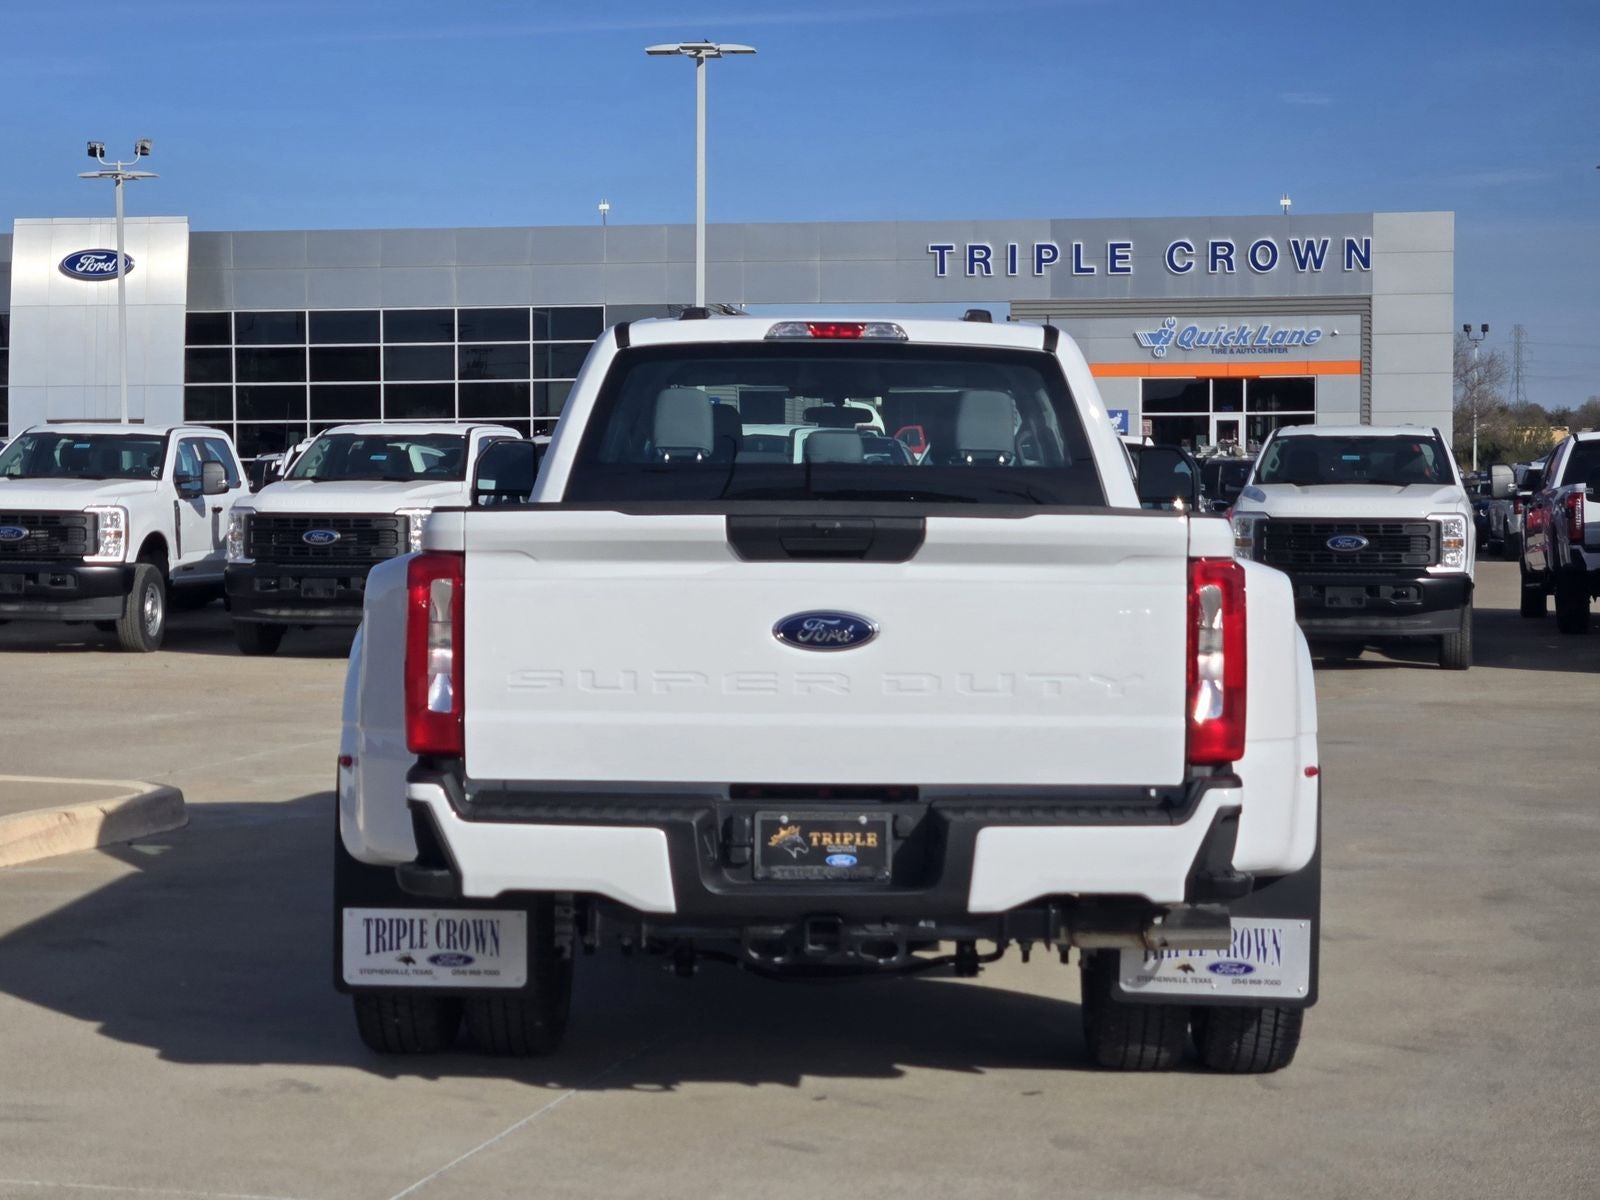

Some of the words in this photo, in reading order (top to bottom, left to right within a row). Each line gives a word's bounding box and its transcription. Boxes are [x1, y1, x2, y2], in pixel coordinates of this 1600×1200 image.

[75, 254, 117, 272] Ford
[928, 241, 1134, 277] TRIPLE
[1165, 237, 1373, 275] CROWN
[1177, 323, 1252, 350] Quick
[1253, 323, 1323, 347] Lane
[1211, 347, 1229, 355] TIRE
[1257, 346, 1288, 354] CENTER
[797, 618, 855, 642] Ford
[505, 668, 851, 695] SUPER
[880, 671, 1146, 697] DUTY
[808, 832, 878, 847] TRIPLE
[363, 917, 429, 956] TRIPLE
[435, 918, 500, 957] CROWN
[1216, 926, 1282, 967] ROWN
[1191, 976, 1213, 984] TEXAS
[1216, 963, 1246, 975] Ford
